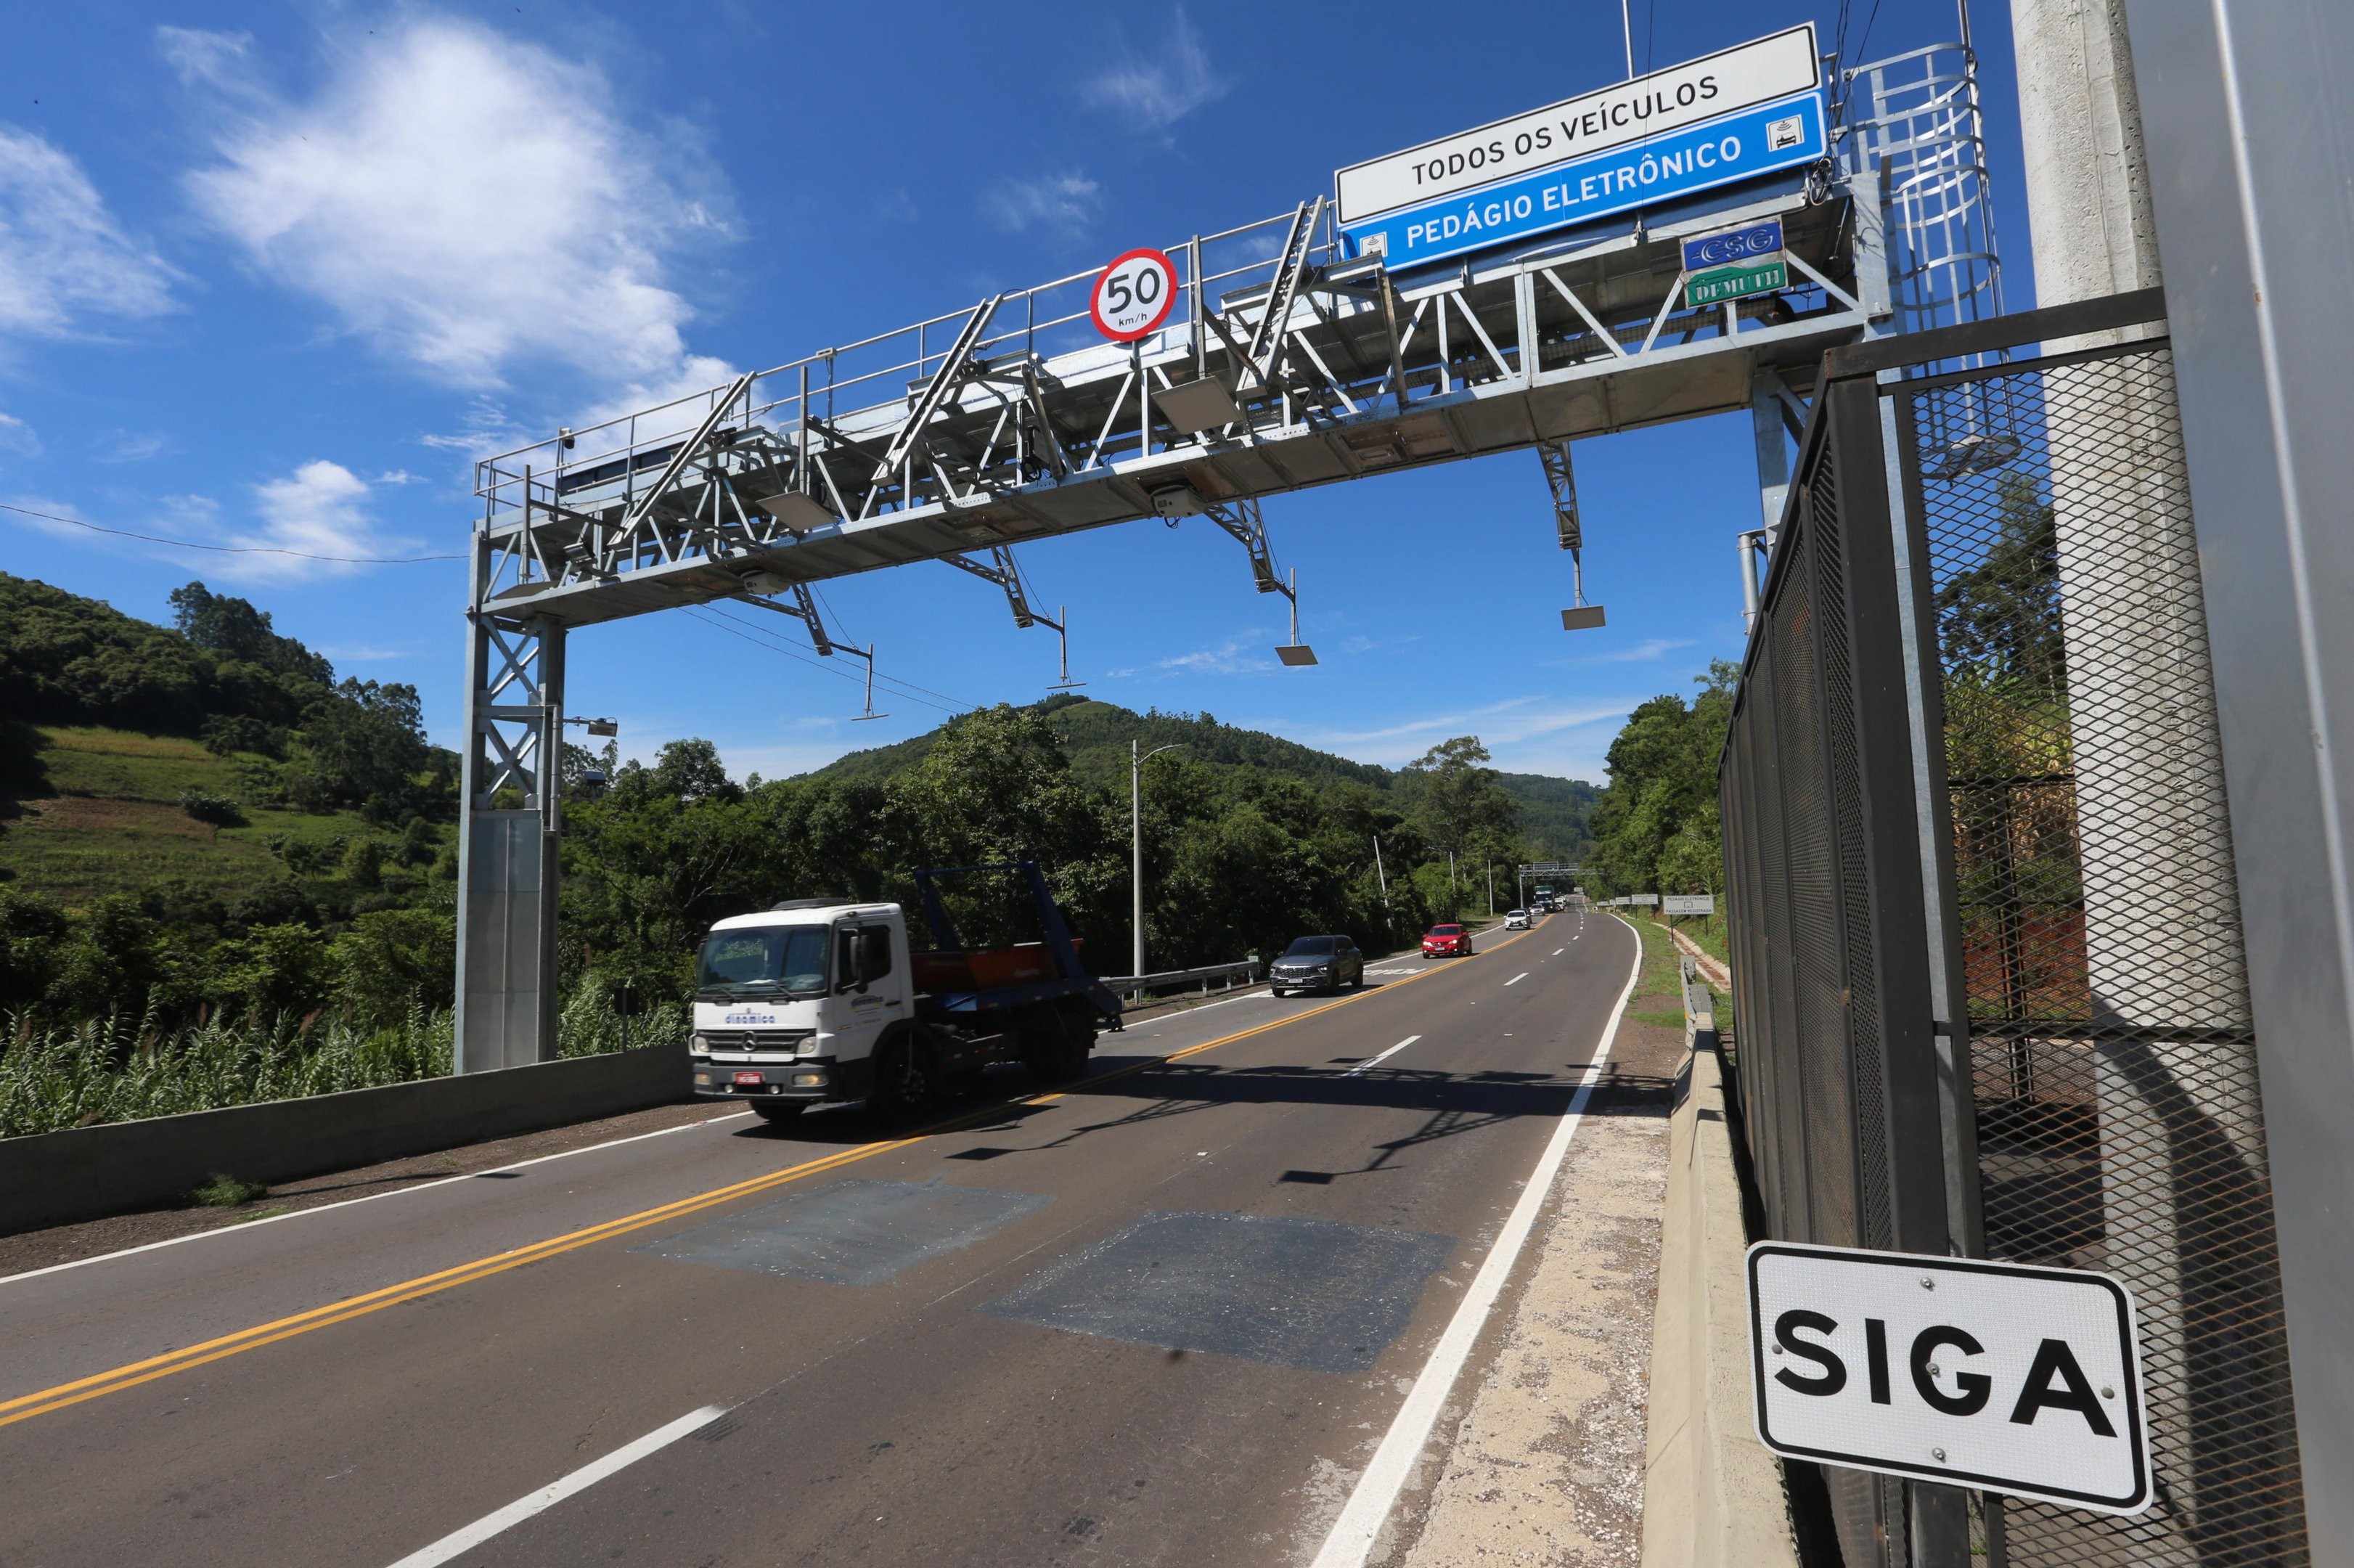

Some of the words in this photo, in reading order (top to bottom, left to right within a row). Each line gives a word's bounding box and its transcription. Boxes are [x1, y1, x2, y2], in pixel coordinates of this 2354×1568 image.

[1412, 141, 1505, 185] TODOS
[1514, 126, 1552, 155] OS
[1561, 75, 1719, 140] VEÍCULOS
[1407, 195, 1532, 248] PEDÁGIO
[1542, 136, 1741, 212] ELETRÔNICO
[1701, 229, 1773, 262] CSG
[1107, 267, 1161, 314] 50
[1696, 269, 1780, 301] DEMUTH
[1118, 312, 1148, 327] km/h
[1773, 1309, 2118, 1438] SIGA
